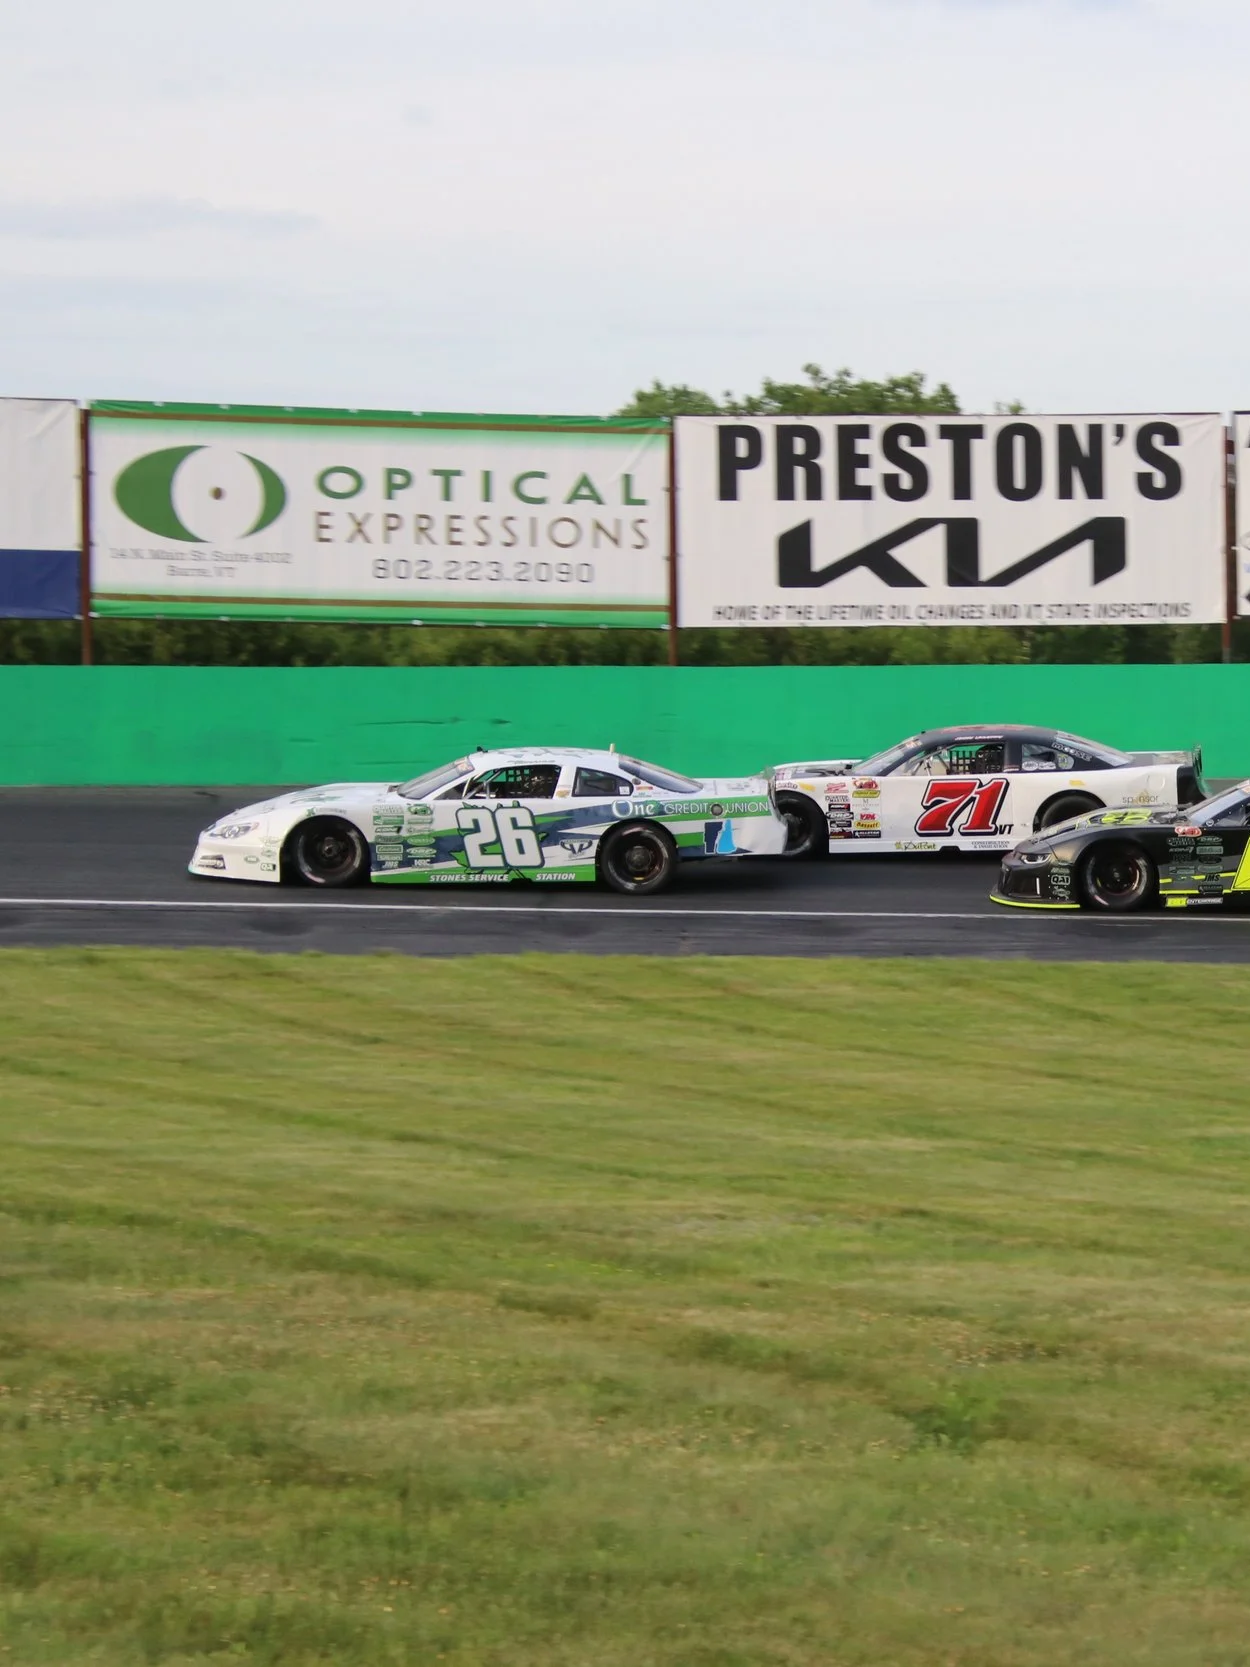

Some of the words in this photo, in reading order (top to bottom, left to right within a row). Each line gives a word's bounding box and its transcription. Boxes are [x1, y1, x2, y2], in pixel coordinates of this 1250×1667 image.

[718, 421, 1182, 502] PRESTON'S
[316, 465, 649, 506] OPTICAL
[313, 510, 650, 549] EXPRESSIONS
[372, 558, 596, 583] 802.223.2090
[777, 516, 1127, 587] KIA
[712, 605, 758, 620] HOME
[761, 605, 782, 620] OF
[786, 605, 815, 620] THE
[611, 800, 655, 818] One
[664, 802, 709, 815] CREDIT
[725, 801, 769, 813] UNION
[914, 778, 1010, 836] 71
[456, 806, 545, 869] 26
[999, 824, 1014, 835] VT
[429, 873, 466, 882] STONES
[469, 873, 509, 882] SERVICE
[536, 873, 576, 882] STATION
